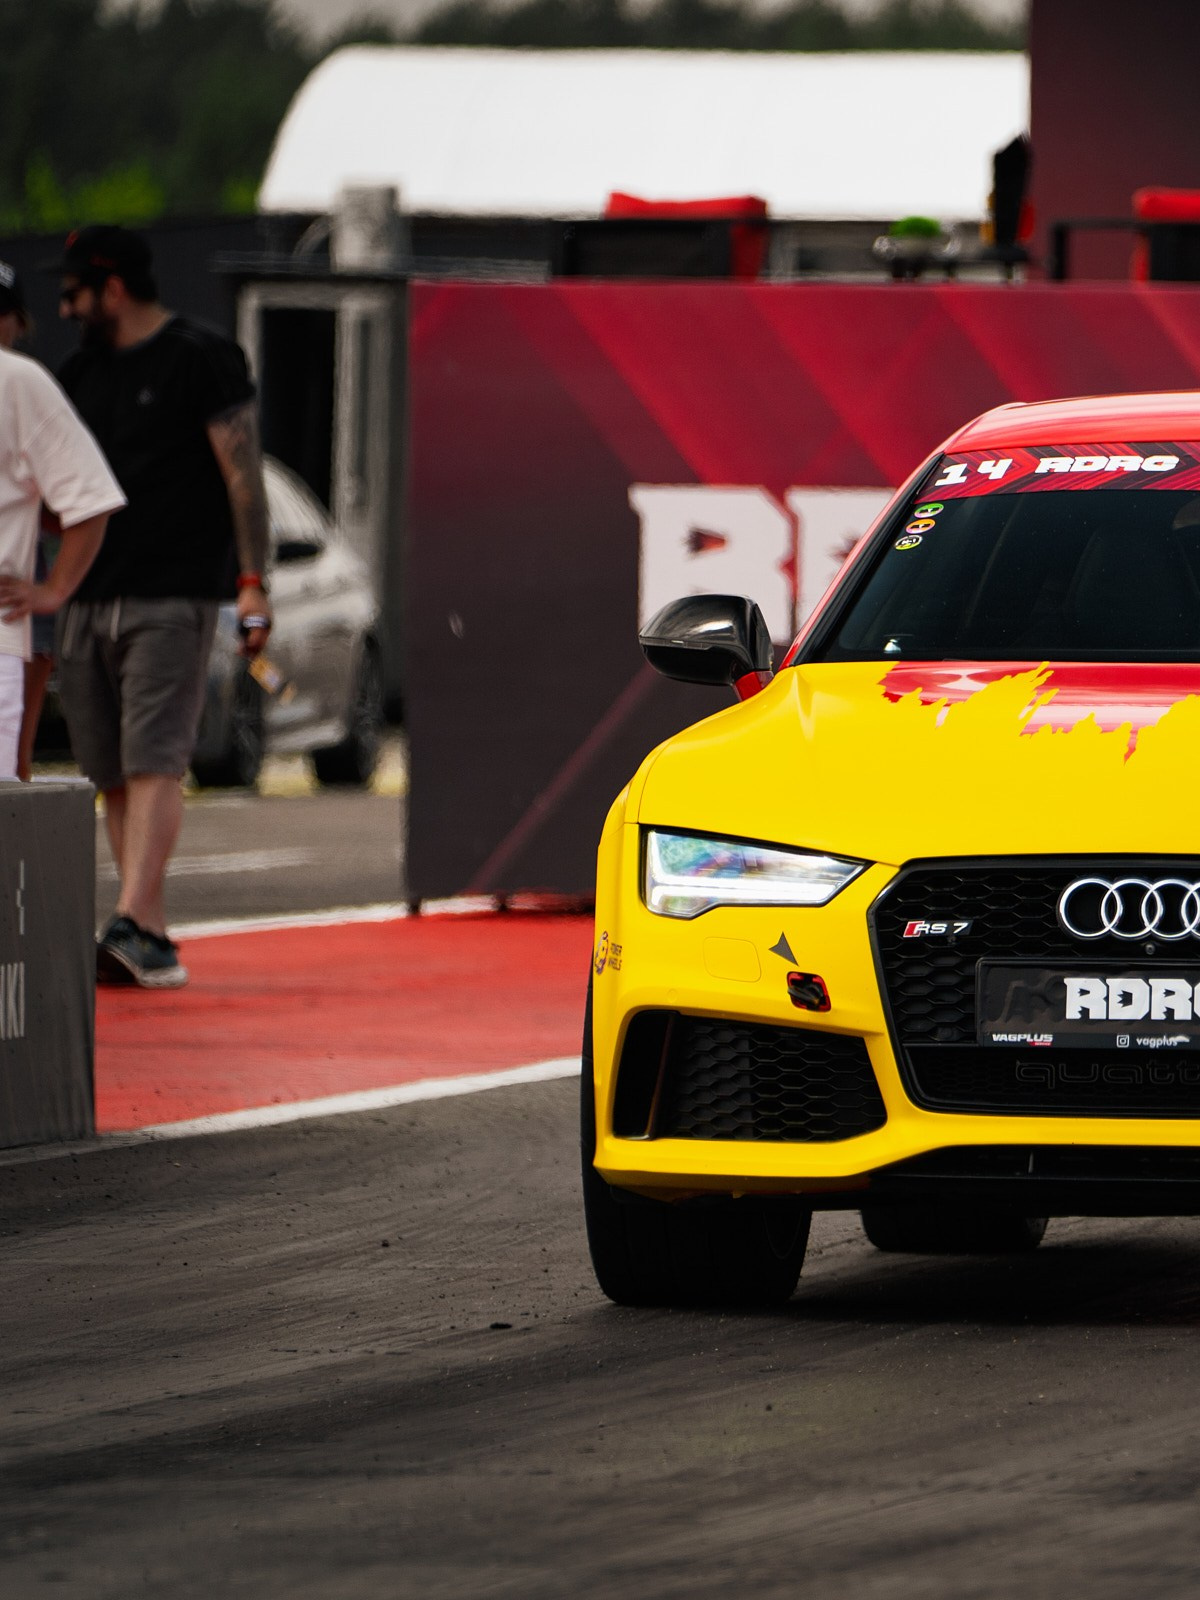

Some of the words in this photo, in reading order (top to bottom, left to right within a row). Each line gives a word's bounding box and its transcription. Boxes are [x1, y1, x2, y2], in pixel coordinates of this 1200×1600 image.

[1035, 455, 1180, 474] RDRC
[903, 920, 948, 938] RS
[953, 922, 969, 934] 7
[992, 1033, 1054, 1043] VAGPLUS
[1136, 1034, 1178, 1049] vagplus
